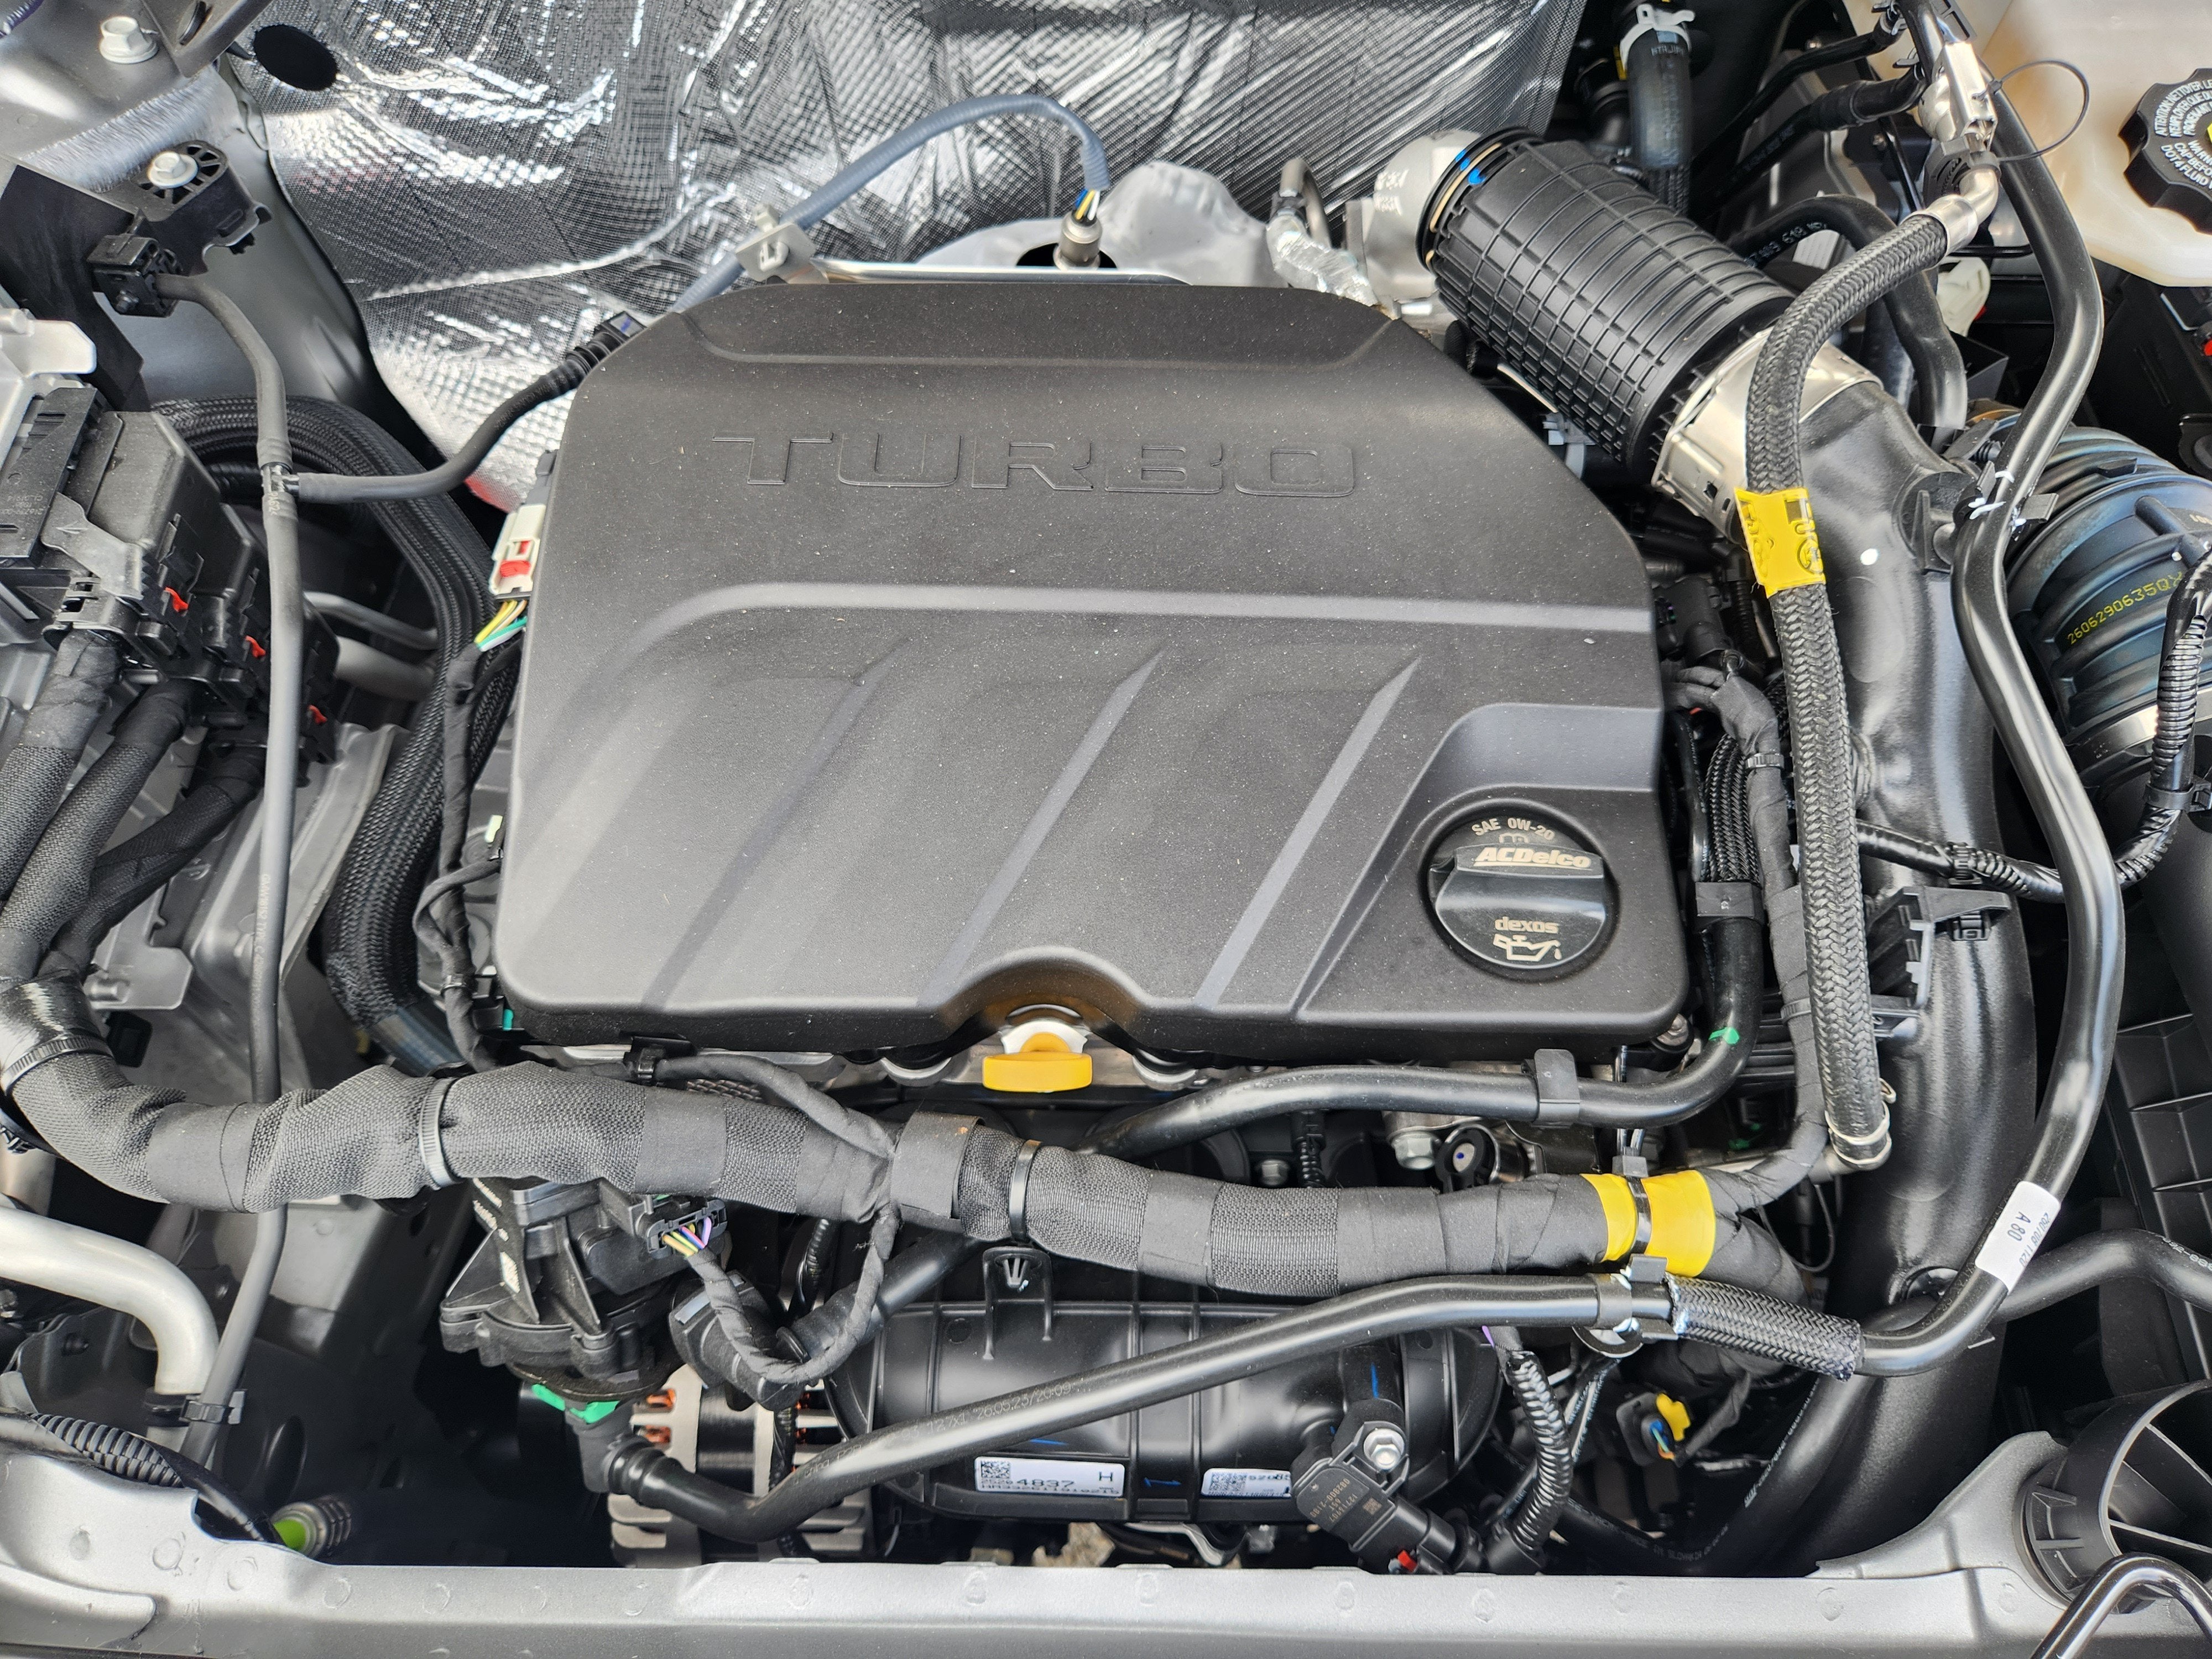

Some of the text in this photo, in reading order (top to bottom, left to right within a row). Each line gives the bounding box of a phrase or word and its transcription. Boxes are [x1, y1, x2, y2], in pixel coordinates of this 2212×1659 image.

[2166, 81, 2204, 103] NETTOYER
[2186, 92, 2205, 105] QUE
[2183, 101, 2210, 136] PROVENANT
[2174, 142, 2193, 158] CAP
[2161, 144, 2182, 161] DOT
[2179, 164, 2209, 186] FLUID
[712, 431, 1355, 497] TURBO
[1472, 817, 1555, 841] SAE 0W-20
[1474, 847, 1592, 868] ACDelco
[1495, 916, 1559, 934] dexos
[2007, 1211, 2031, 1241] A 80
[1016, 1478, 1074, 1488] 4837
[1099, 1471, 1113, 1482] H
